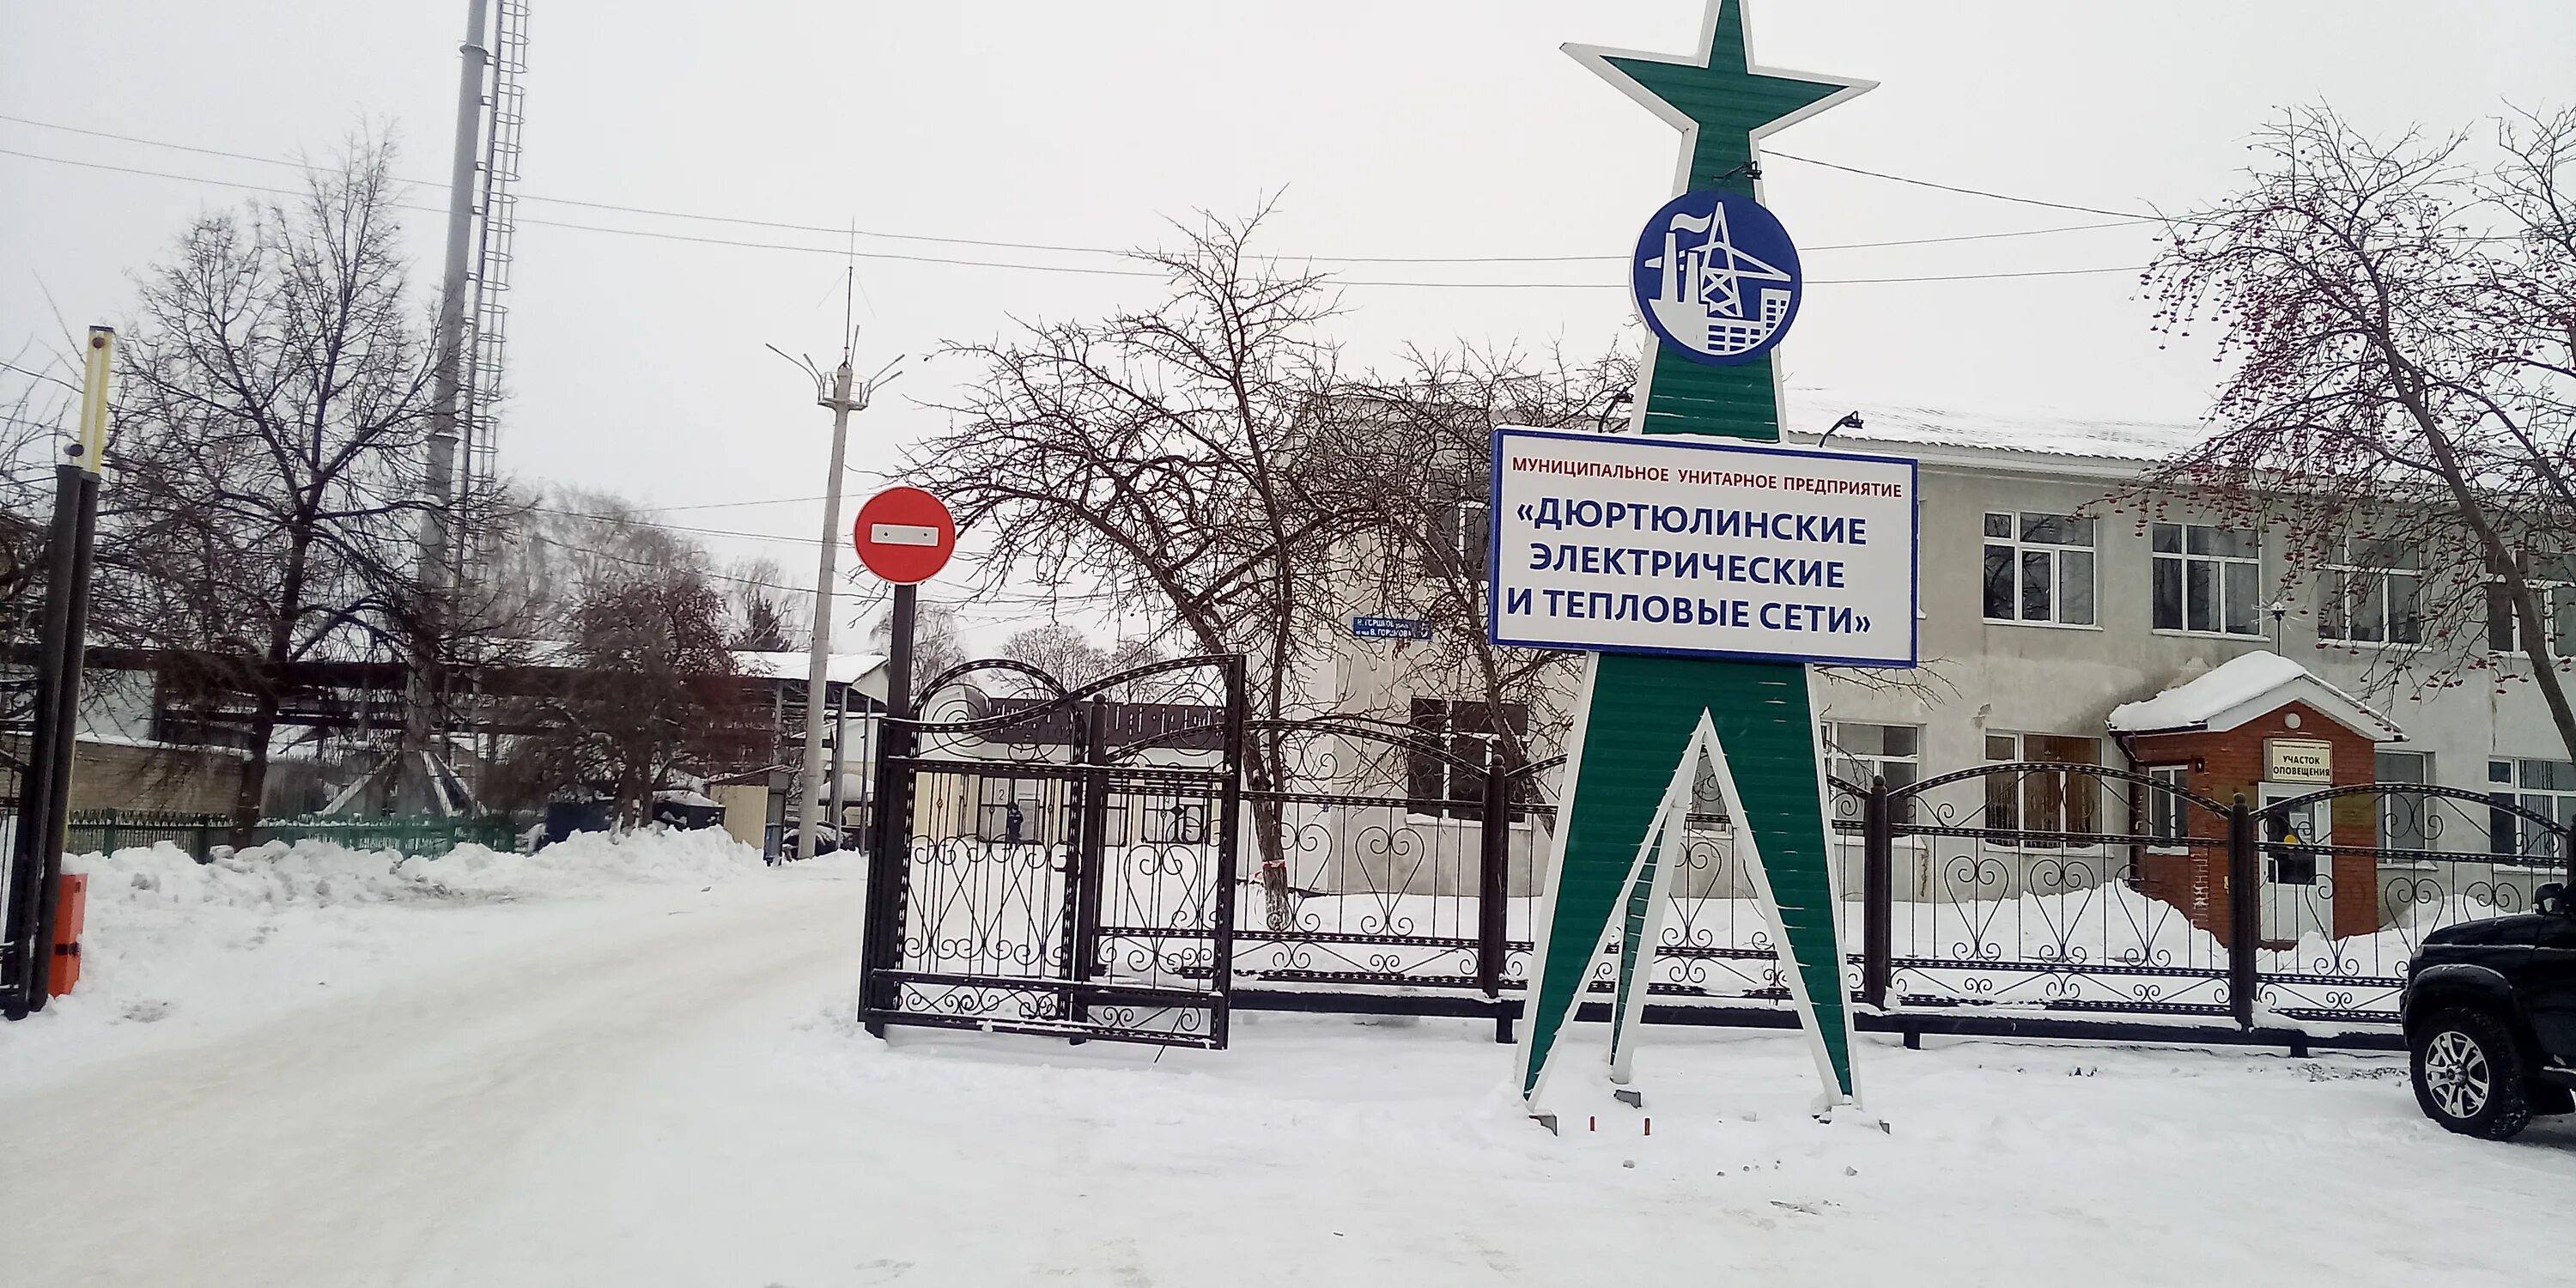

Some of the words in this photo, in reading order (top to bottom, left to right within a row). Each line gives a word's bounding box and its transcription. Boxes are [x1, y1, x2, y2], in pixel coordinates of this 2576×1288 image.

[1512, 457, 1669, 482] МУНИЦИПАЛЬНОЕ
[1678, 469, 1777, 489] УНИТАРНОЕ
[1783, 477, 1902, 497] ПРЕДПРИЯТИЕ
[1516, 497, 1867, 545] «ДЮРТЮЛИНСКИЕ
[1529, 543, 1844, 588] ЭЛЕКТРИЧЕСКИЕ
[1507, 587, 1532, 615] И
[1542, 589, 1749, 628] ТЕПЛОВЫЕ
[1759, 602, 1871, 634] СЕТИ»
[2273, 766, 2330, 777] ОПОВЕЩЕНИЯ
[2282, 756, 2320, 764] УЧАСТОК
[999, 789, 1005, 800] 2
